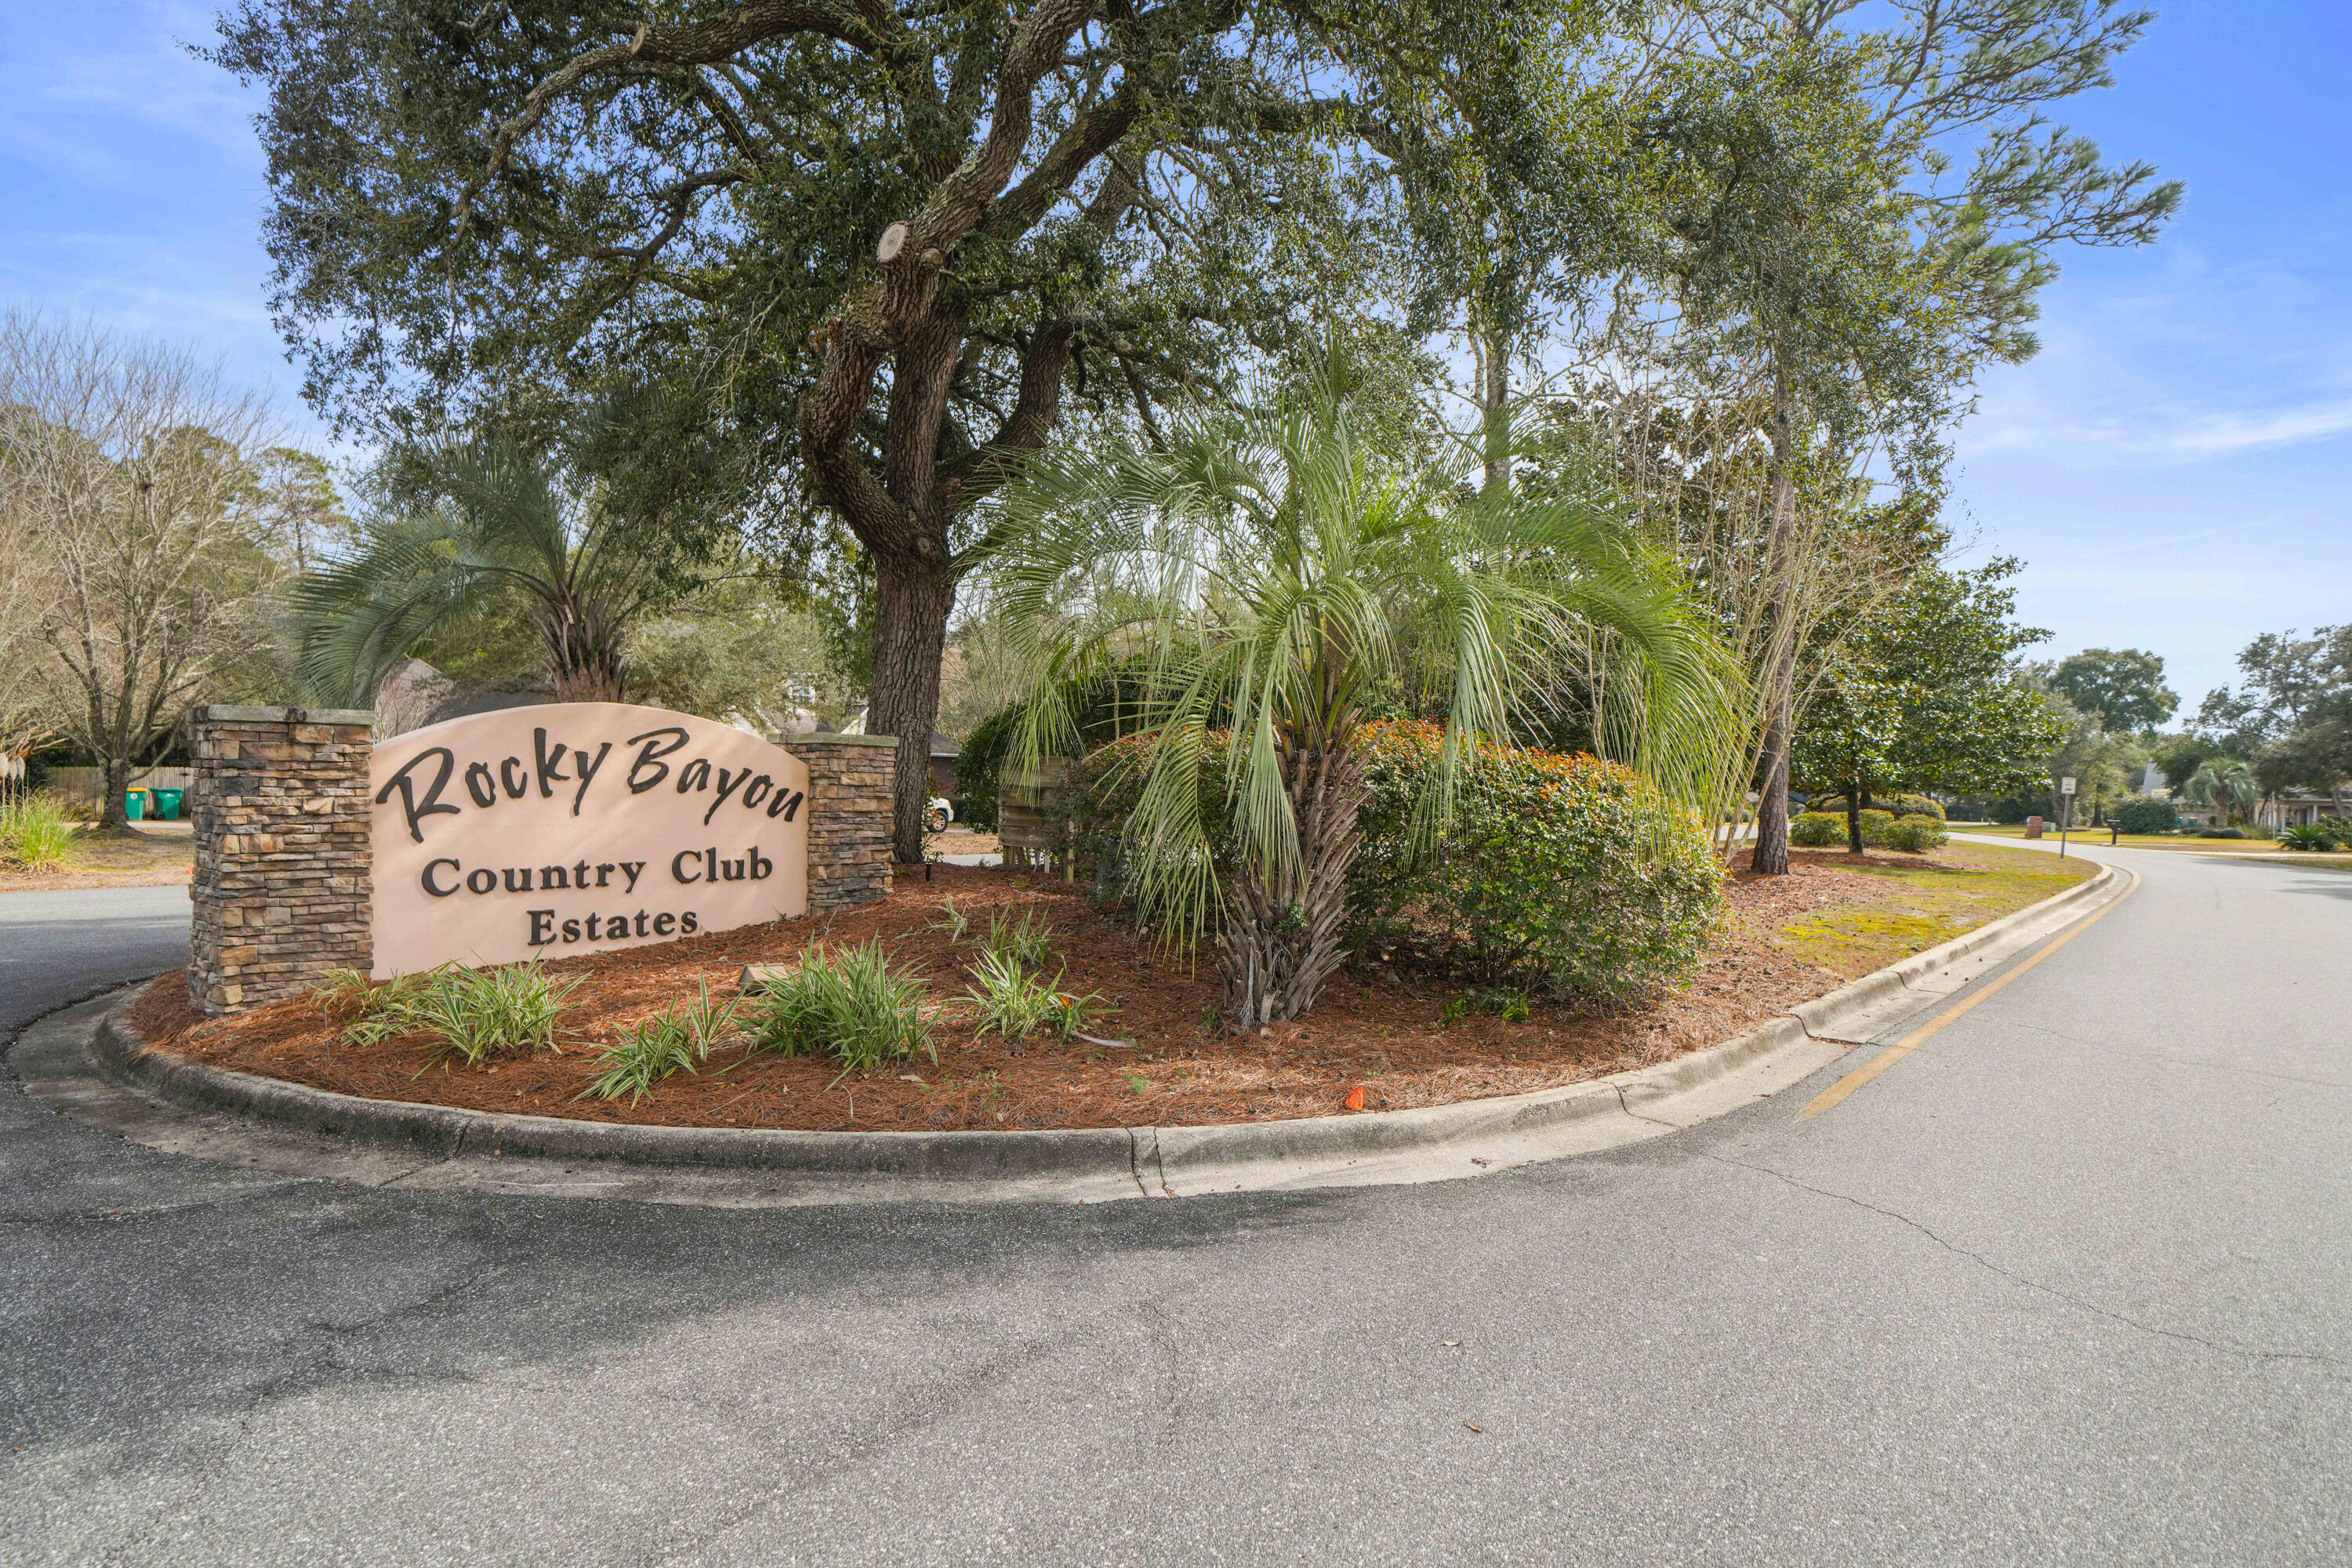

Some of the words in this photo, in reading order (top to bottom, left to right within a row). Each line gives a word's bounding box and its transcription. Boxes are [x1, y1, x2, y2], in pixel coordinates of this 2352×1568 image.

[376, 727, 612, 844] Rocky
[626, 727, 804, 826] Bayou
[421, 858, 647, 898] Country
[671, 845, 773, 885] Club
[526, 909, 698, 946] Estates
